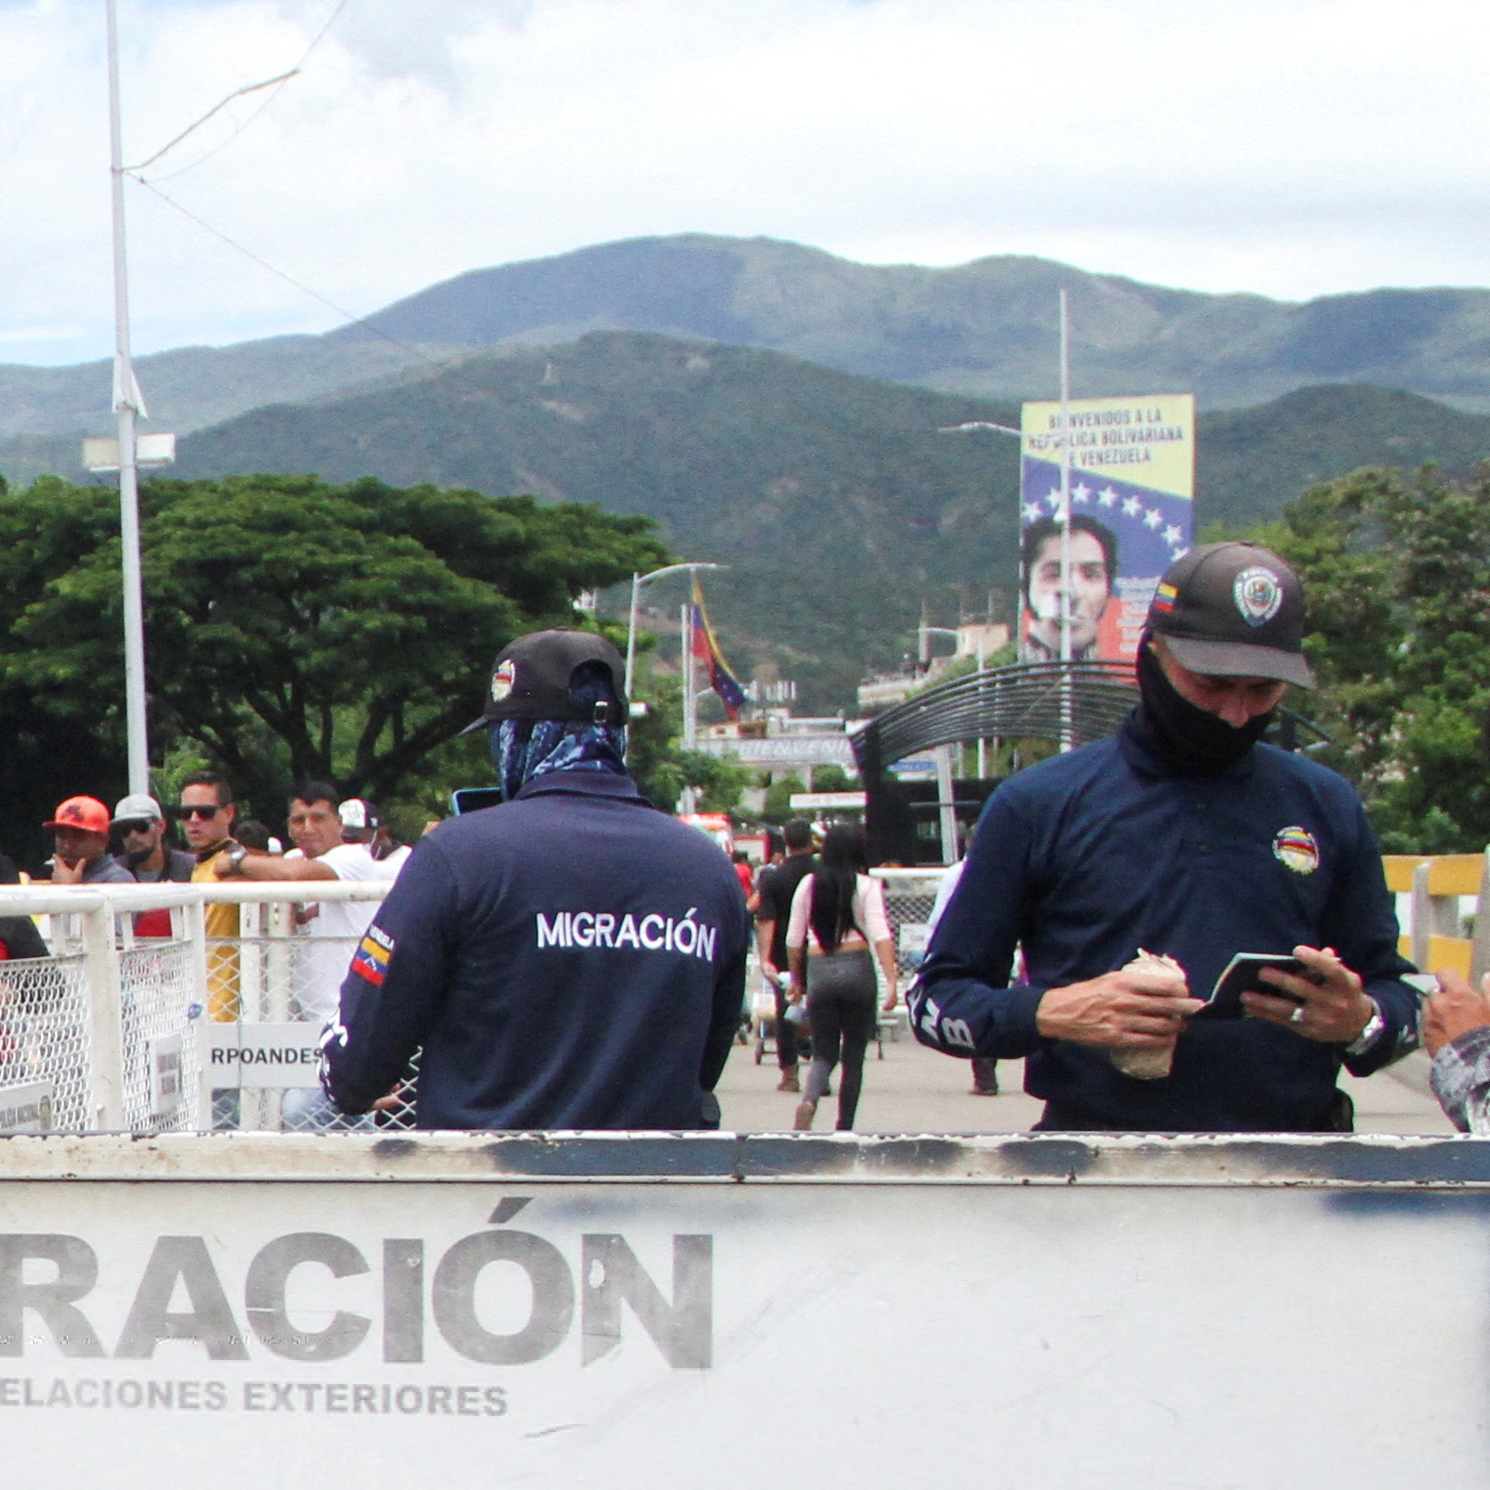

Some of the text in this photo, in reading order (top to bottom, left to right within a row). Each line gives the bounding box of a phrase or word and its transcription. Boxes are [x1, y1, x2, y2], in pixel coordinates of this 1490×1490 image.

[1048, 408, 1161, 429] BINVENIDOS A LA
[1101, 426, 1182, 445] BOLIVARIANA
[1080, 449, 1151, 466] VENEZUELA
[536, 907, 716, 962] MIGRACIÓN
[243, 1381, 509, 1417] EXTERIORES
